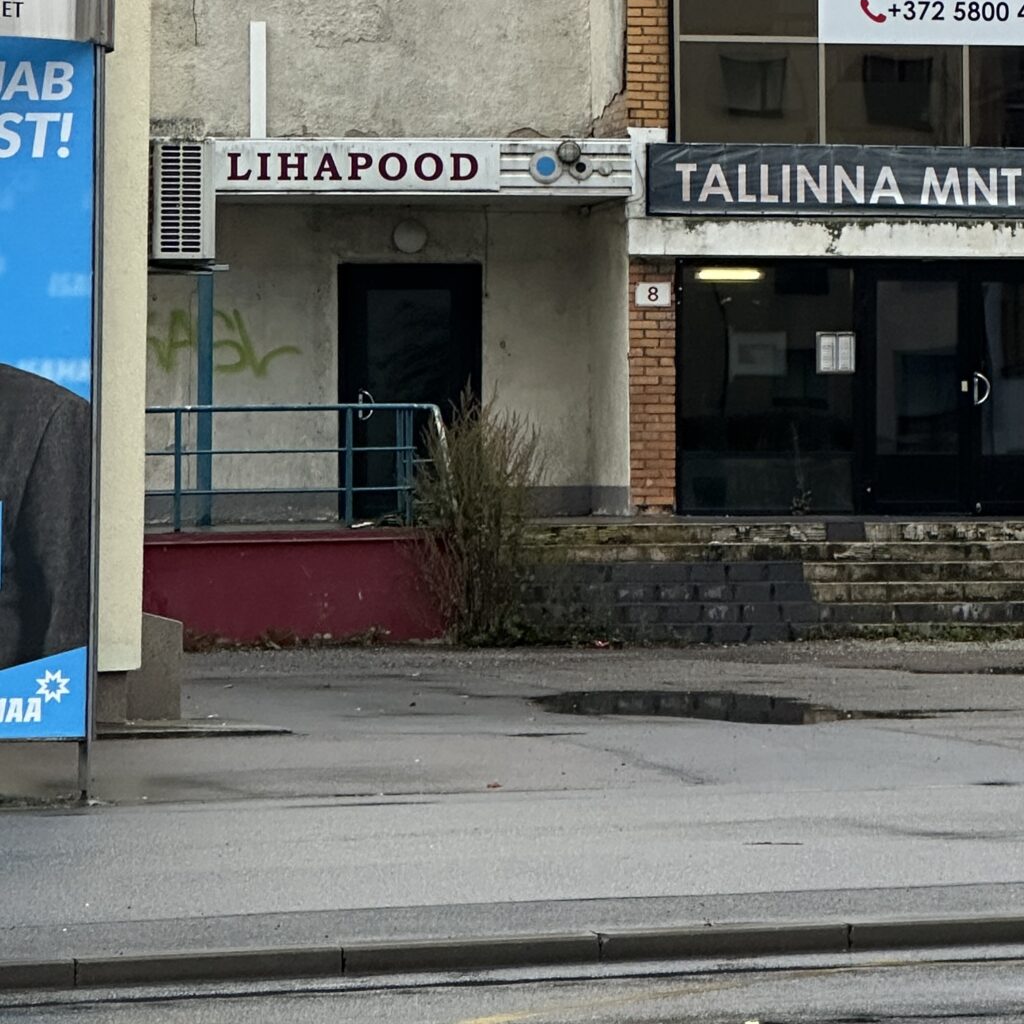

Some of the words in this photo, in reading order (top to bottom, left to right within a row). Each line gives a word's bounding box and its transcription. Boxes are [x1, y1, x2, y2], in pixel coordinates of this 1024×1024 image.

[888, 0, 945, 21] +372
[953, 1, 1010, 22] 5800
[0, 61, 74, 101] AB
[0, 112, 73, 158] ST!
[227, 152, 479, 182] LIHAPOOD
[675, 163, 905, 204] TALLINNA
[920, 166, 1022, 206] MNT
[648, 286, 659, 302] 8
[0, 697, 42, 723] AA
